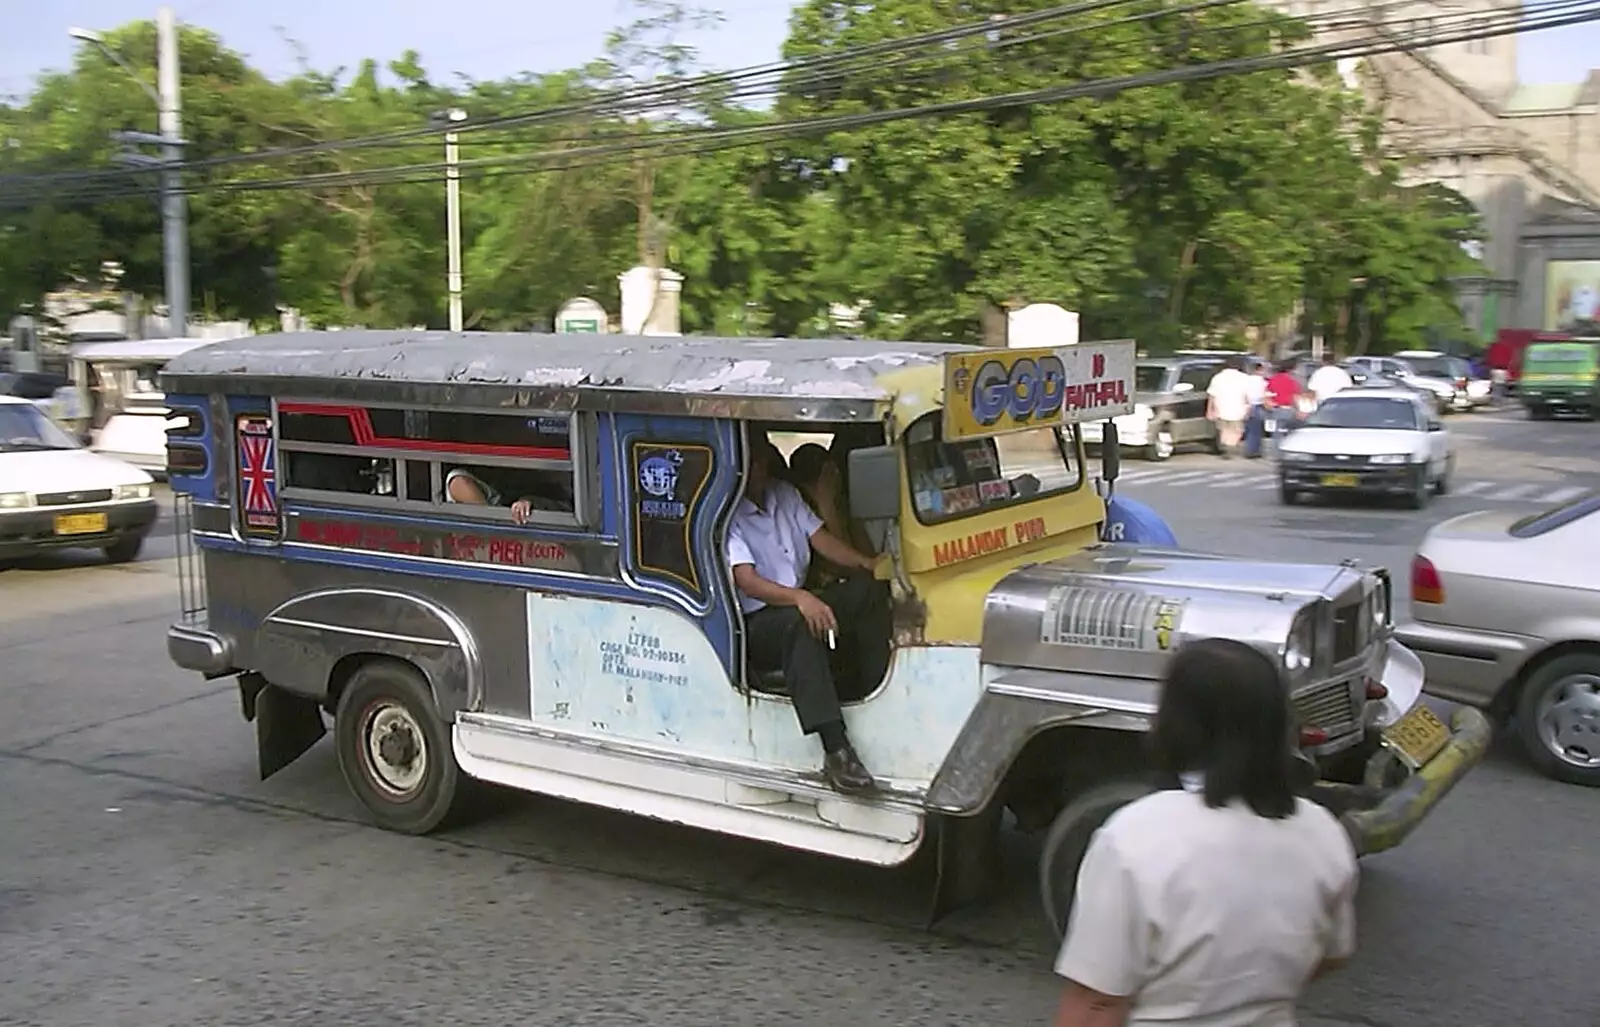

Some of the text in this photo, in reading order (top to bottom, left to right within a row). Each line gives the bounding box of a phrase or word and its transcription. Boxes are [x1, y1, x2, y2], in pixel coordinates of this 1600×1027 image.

[971, 355, 1066, 426] GOD
[1065, 380, 1128, 411] FAITHFUL
[488, 537, 523, 564] PIER
[933, 517, 1047, 566] MALANDAY PIER
[600, 641, 622, 653] CASE
